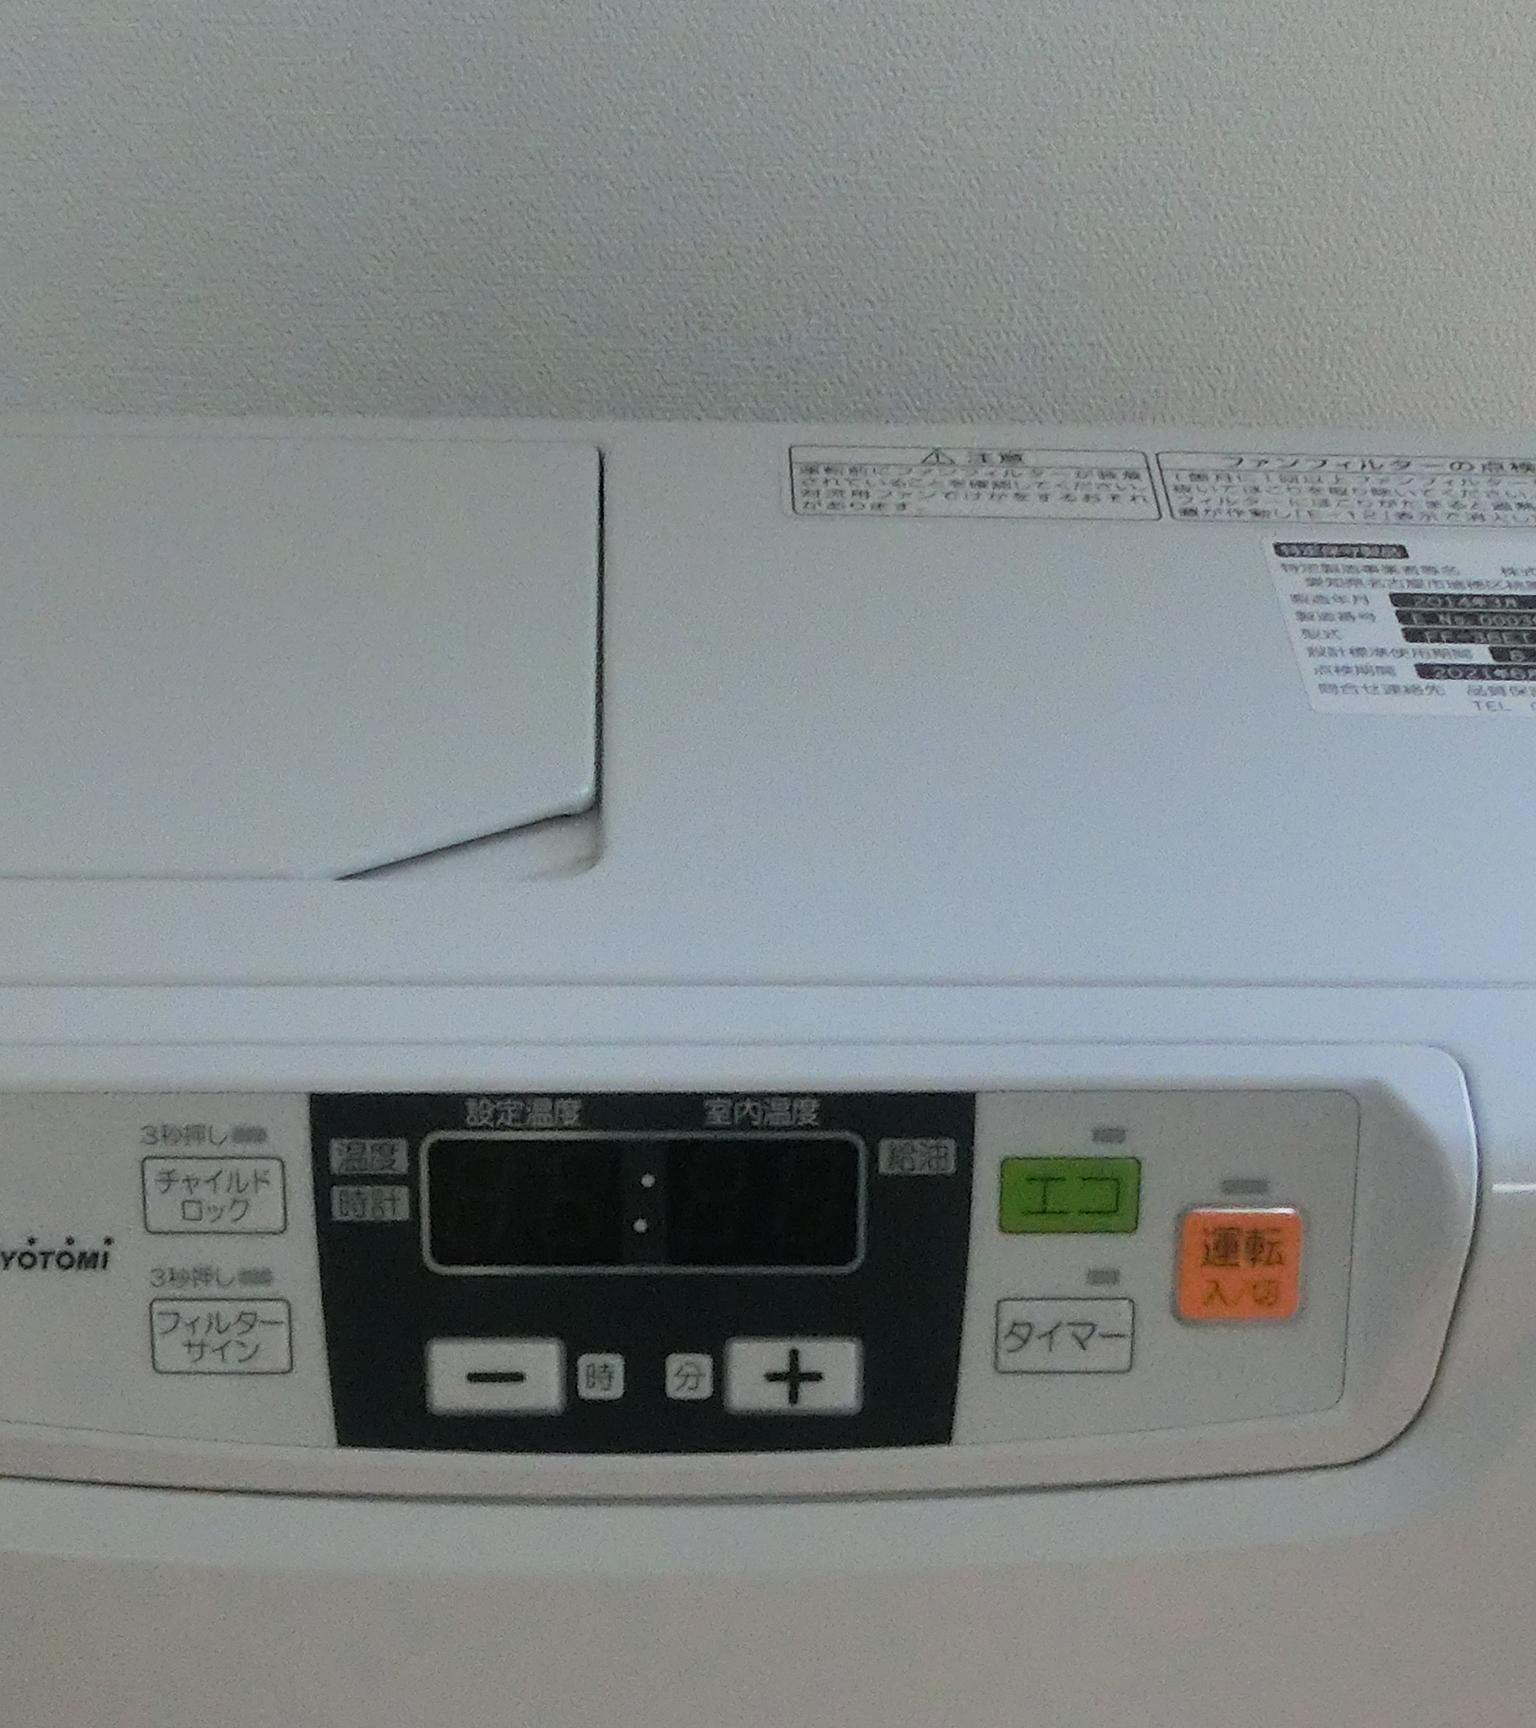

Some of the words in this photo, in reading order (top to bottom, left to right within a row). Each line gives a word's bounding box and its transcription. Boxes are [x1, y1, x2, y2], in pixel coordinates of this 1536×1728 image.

[1472, 699, 1513, 713] TEL
[704, 1097, 820, 1128] 室内温度
[140, 1123, 229, 1147] 3秒押し
[154, 1167, 271, 1195] チャイルド
[1021, 1175, 1123, 1216] エコ
[180, 1199, 250, 1223] ロック
[1200, 1226, 1286, 1268] 運転
[149, 1266, 235, 1289] 3秒押し
[156, 1310, 285, 1336] フィルター
[181, 1338, 261, 1364] サイン
[1005, 1321, 1127, 1354] タイマー
[585, 1361, 615, 1391] 時
[673, 1361, 705, 1393] 分
